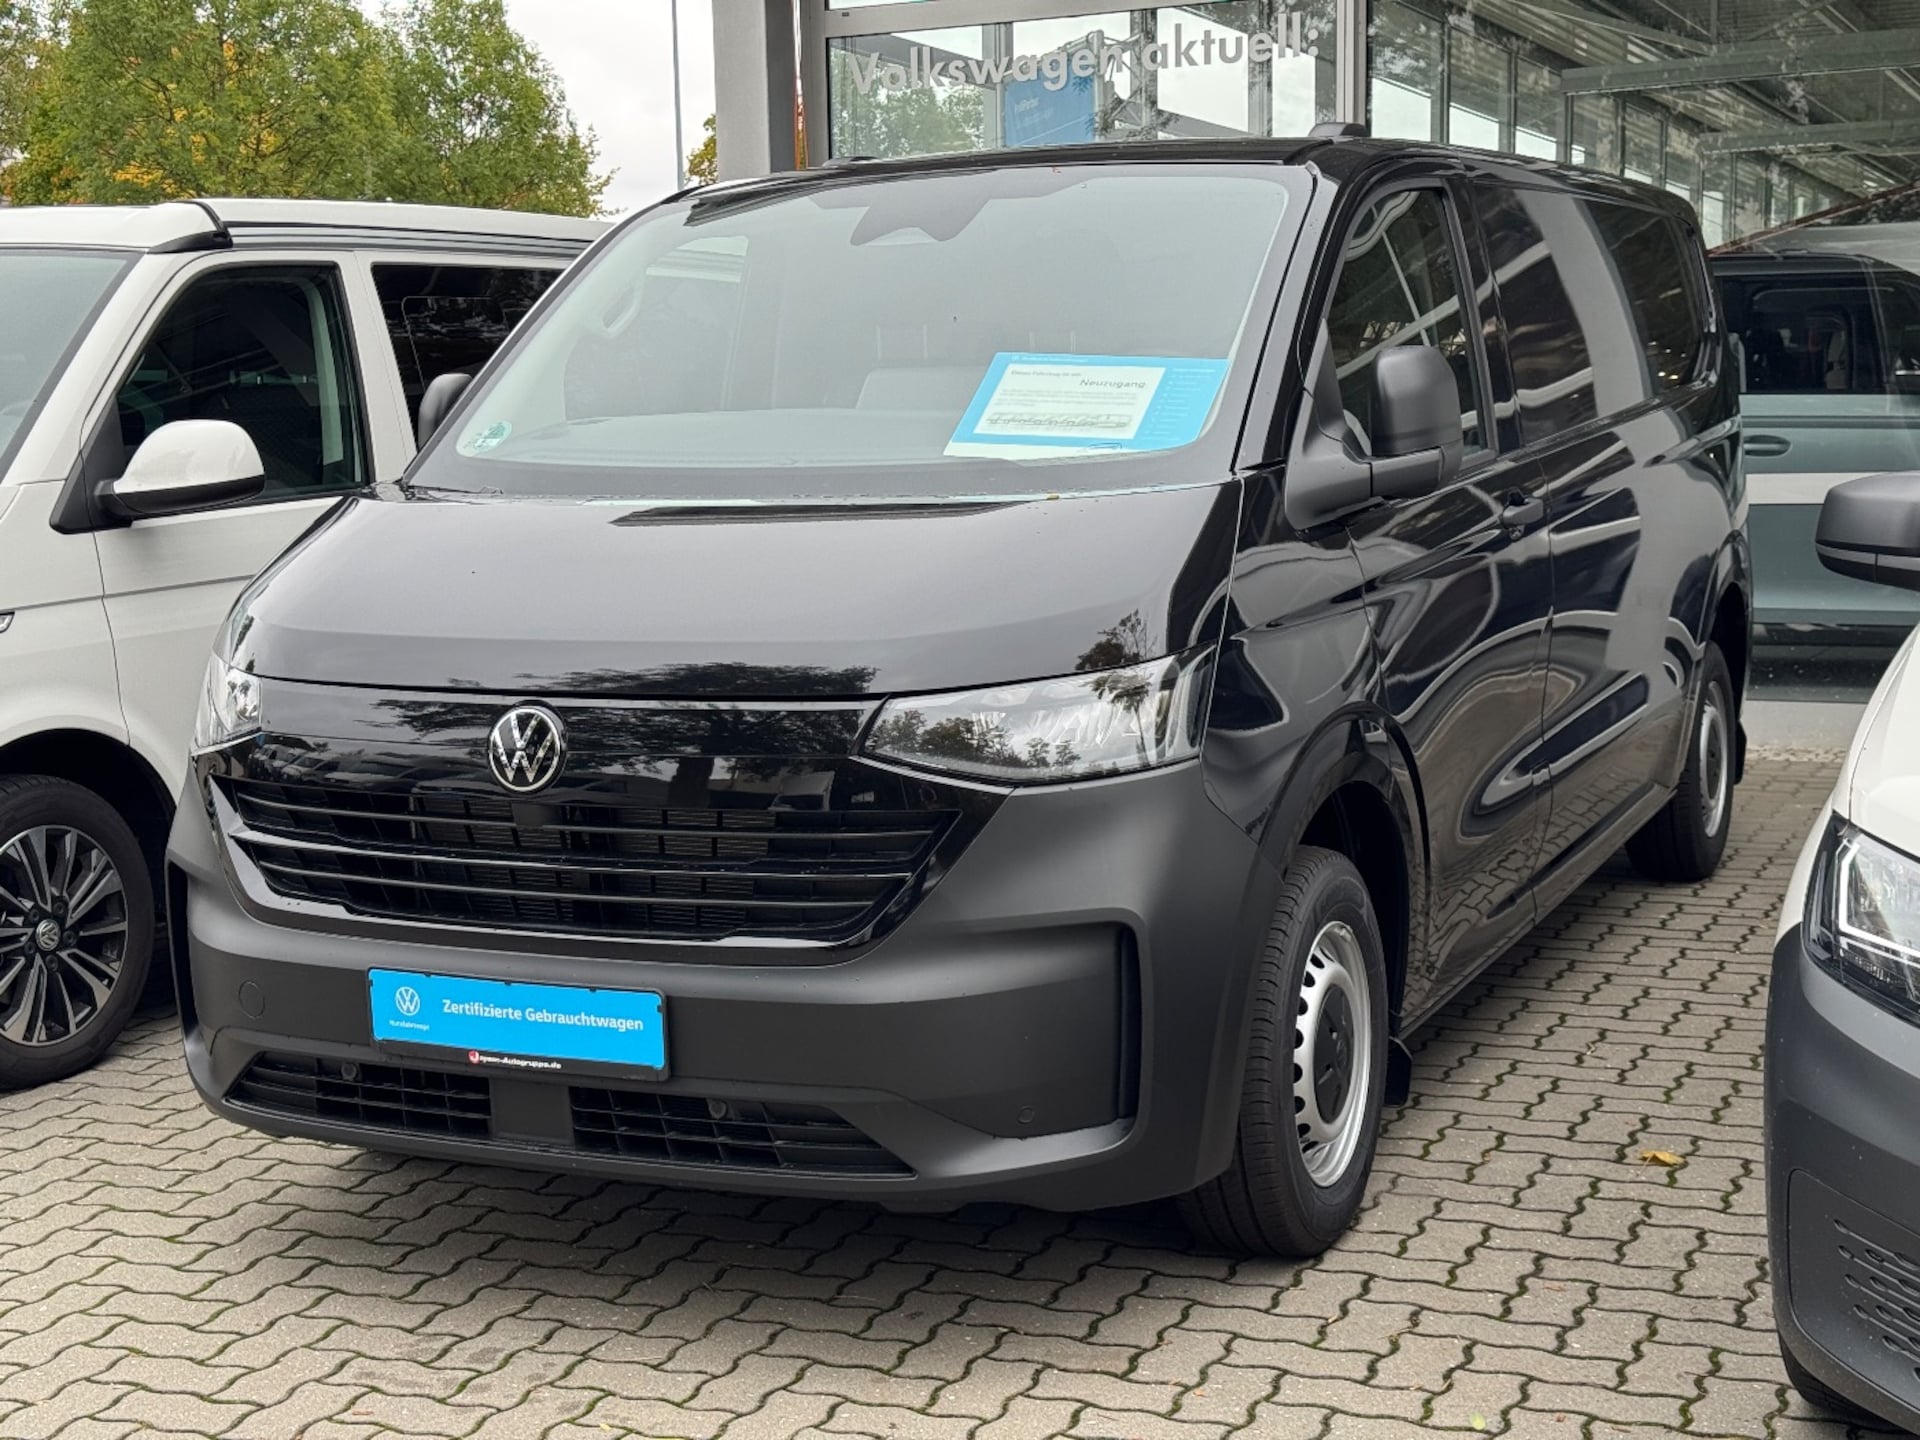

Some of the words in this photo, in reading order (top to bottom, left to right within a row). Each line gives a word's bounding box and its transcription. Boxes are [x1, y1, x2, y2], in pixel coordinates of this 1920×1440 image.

[850, 45, 1123, 94] Volkswagen
[1142, 11, 1319, 70] aktuell:
[1079, 378, 1146, 389] Neuzugang
[442, 998, 522, 1020] Zertifizierte
[525, 1007, 643, 1032] Gebrauchtwagen
